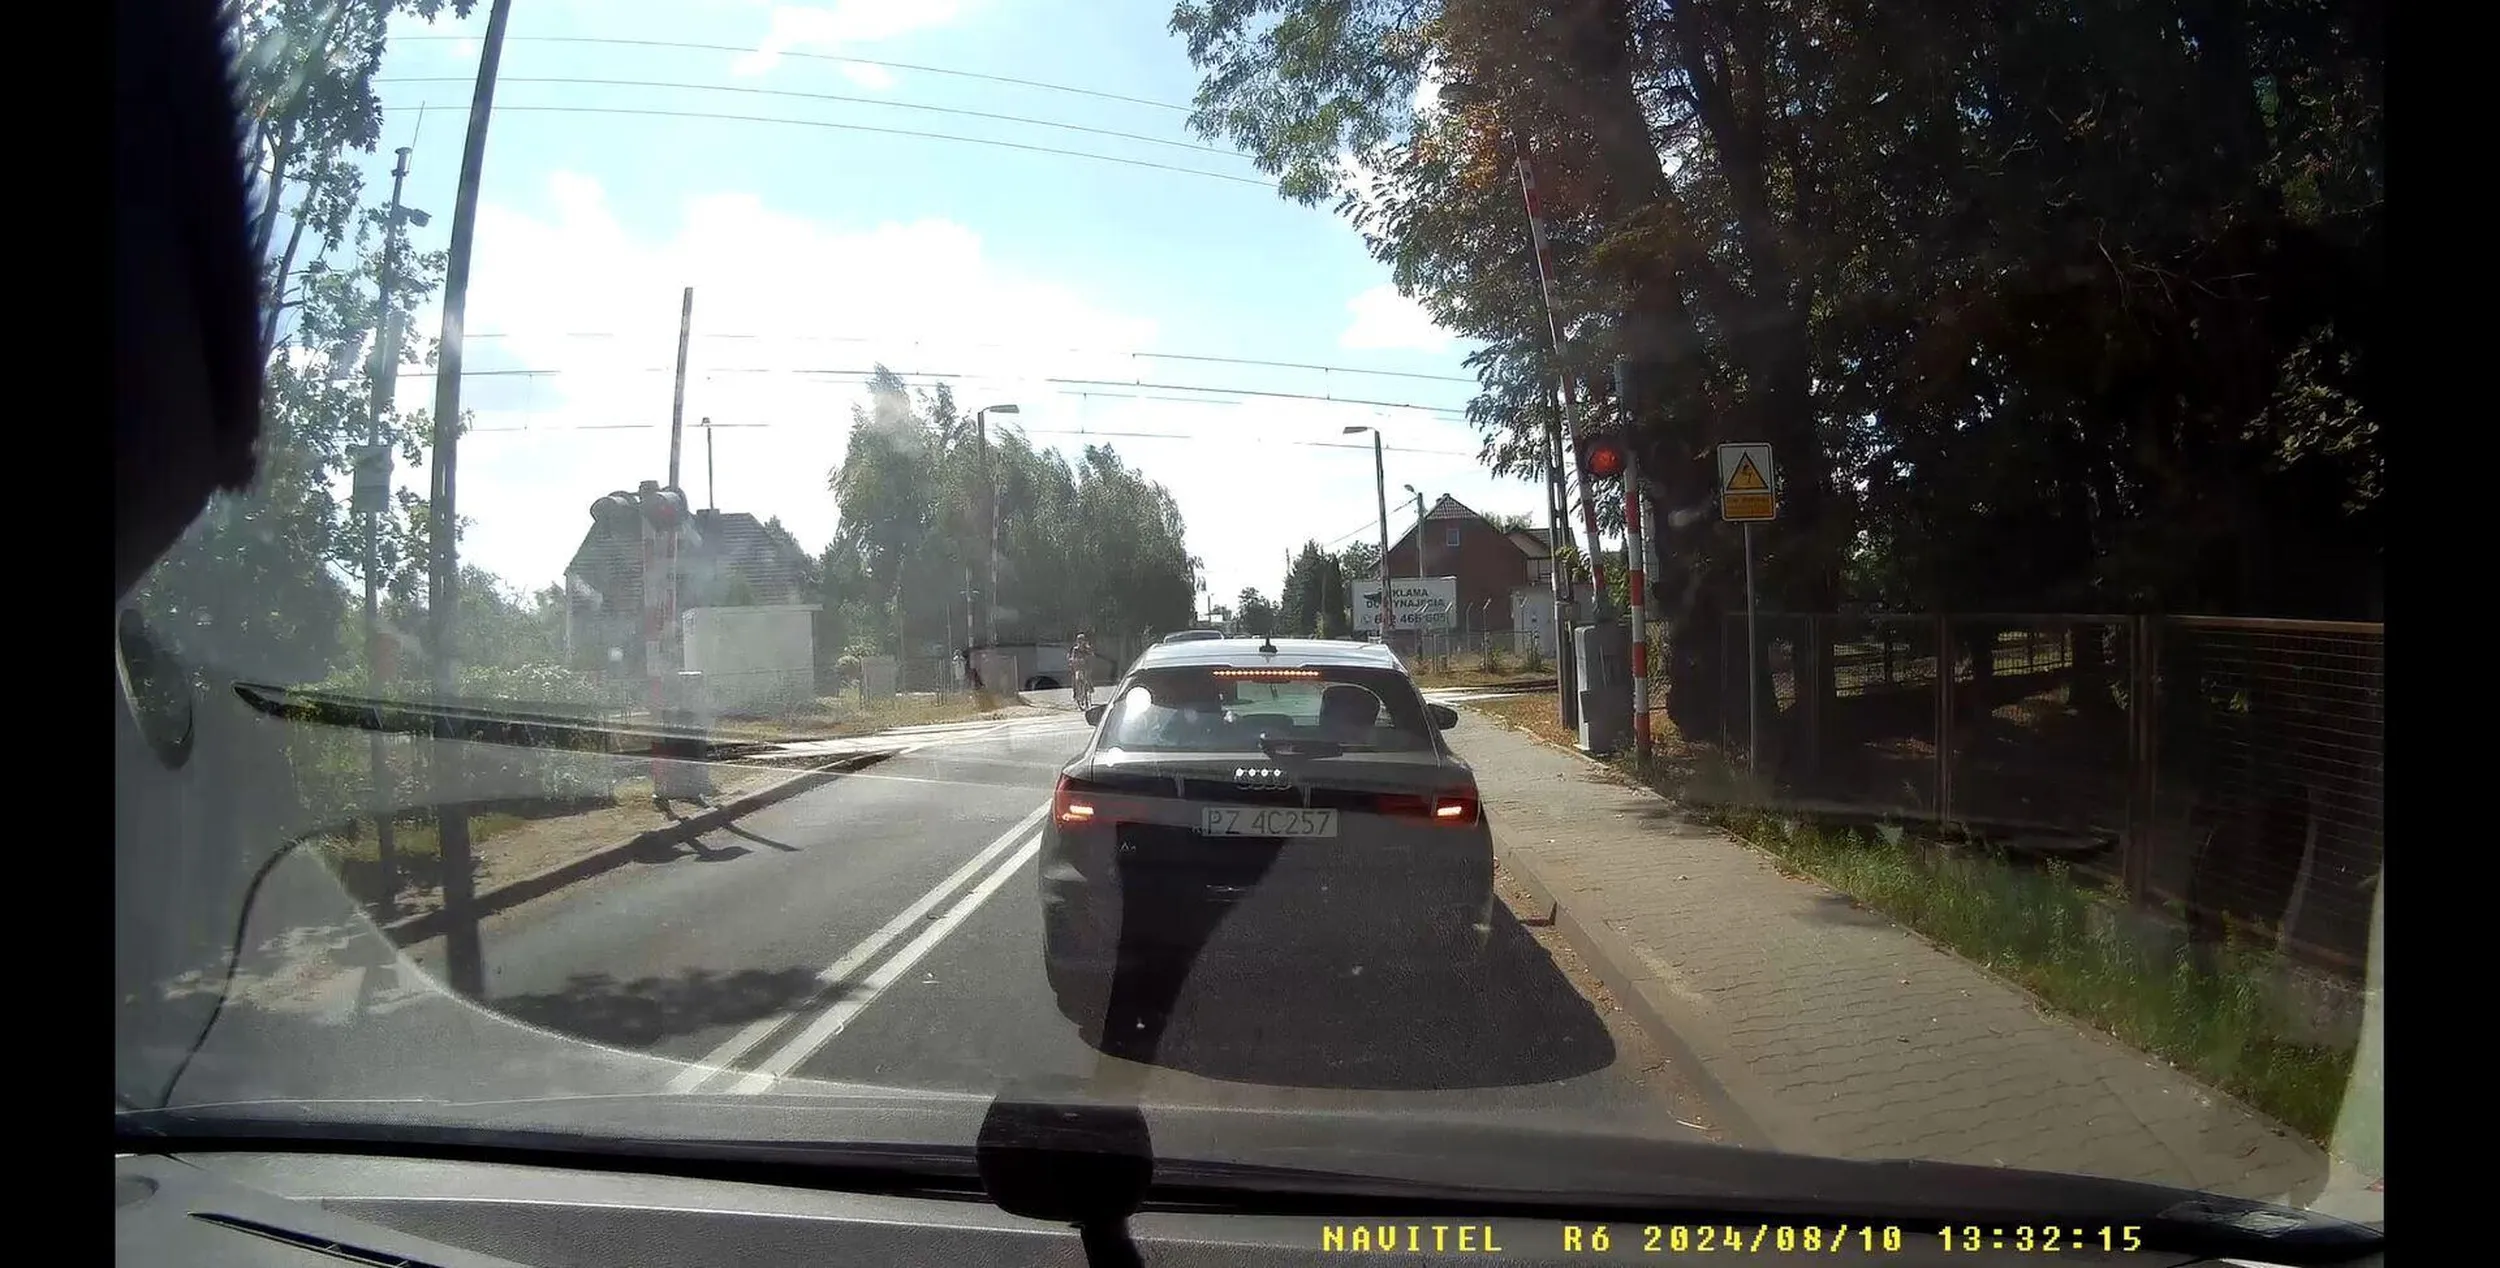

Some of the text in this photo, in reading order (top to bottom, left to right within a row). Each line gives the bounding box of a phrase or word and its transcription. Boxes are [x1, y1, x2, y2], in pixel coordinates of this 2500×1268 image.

[1381, 588, 1429, 598] KLAMA
[1383, 598, 1446, 608] YNAJCIA
[1208, 810, 1331, 835] PZ 4C257
